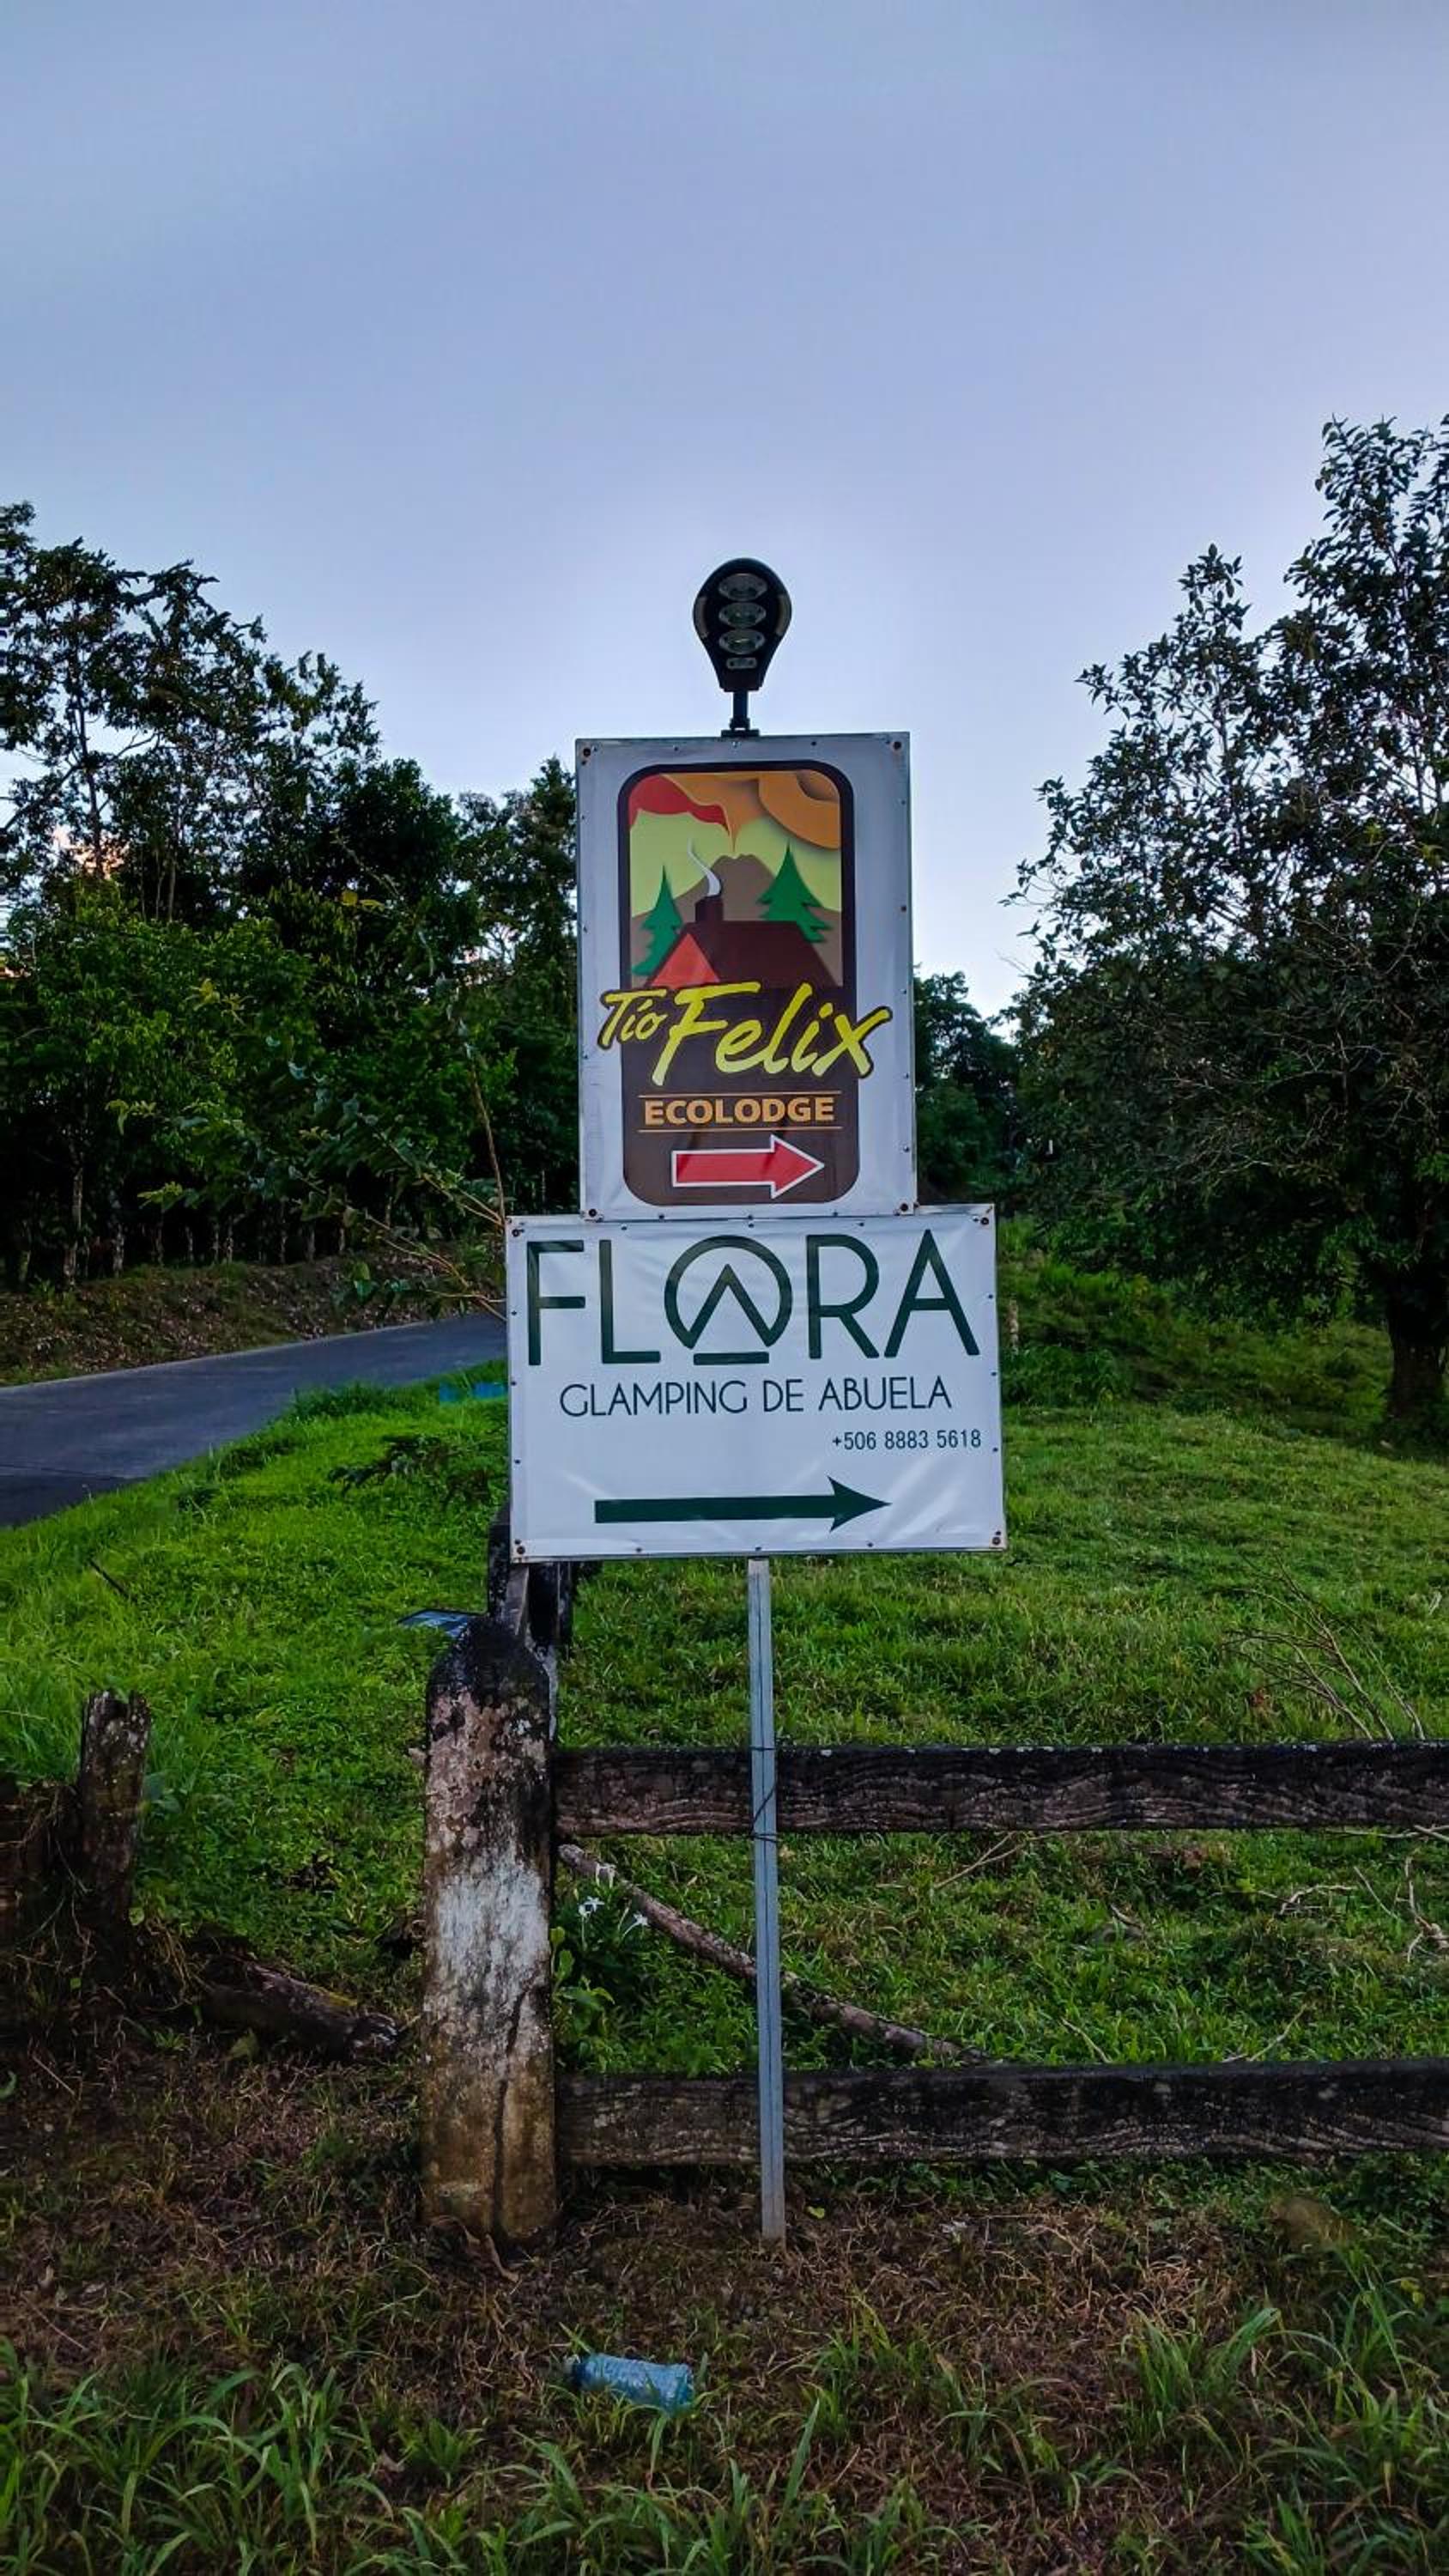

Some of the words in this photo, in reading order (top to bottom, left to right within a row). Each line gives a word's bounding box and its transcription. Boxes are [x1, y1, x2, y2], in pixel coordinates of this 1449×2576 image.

[651, 981, 893, 1086] Felix
[645, 1097, 834, 1125] ECOLODGE
[526, 1229, 979, 1365] FLORA
[559, 1380, 748, 1417] GLAMPING
[762, 1379, 804, 1412] DE
[817, 1375, 952, 1411] ABUELA
[832, 1431, 876, 1450] +506
[884, 1430, 929, 1449] 8883
[936, 1429, 981, 1449] 5618
